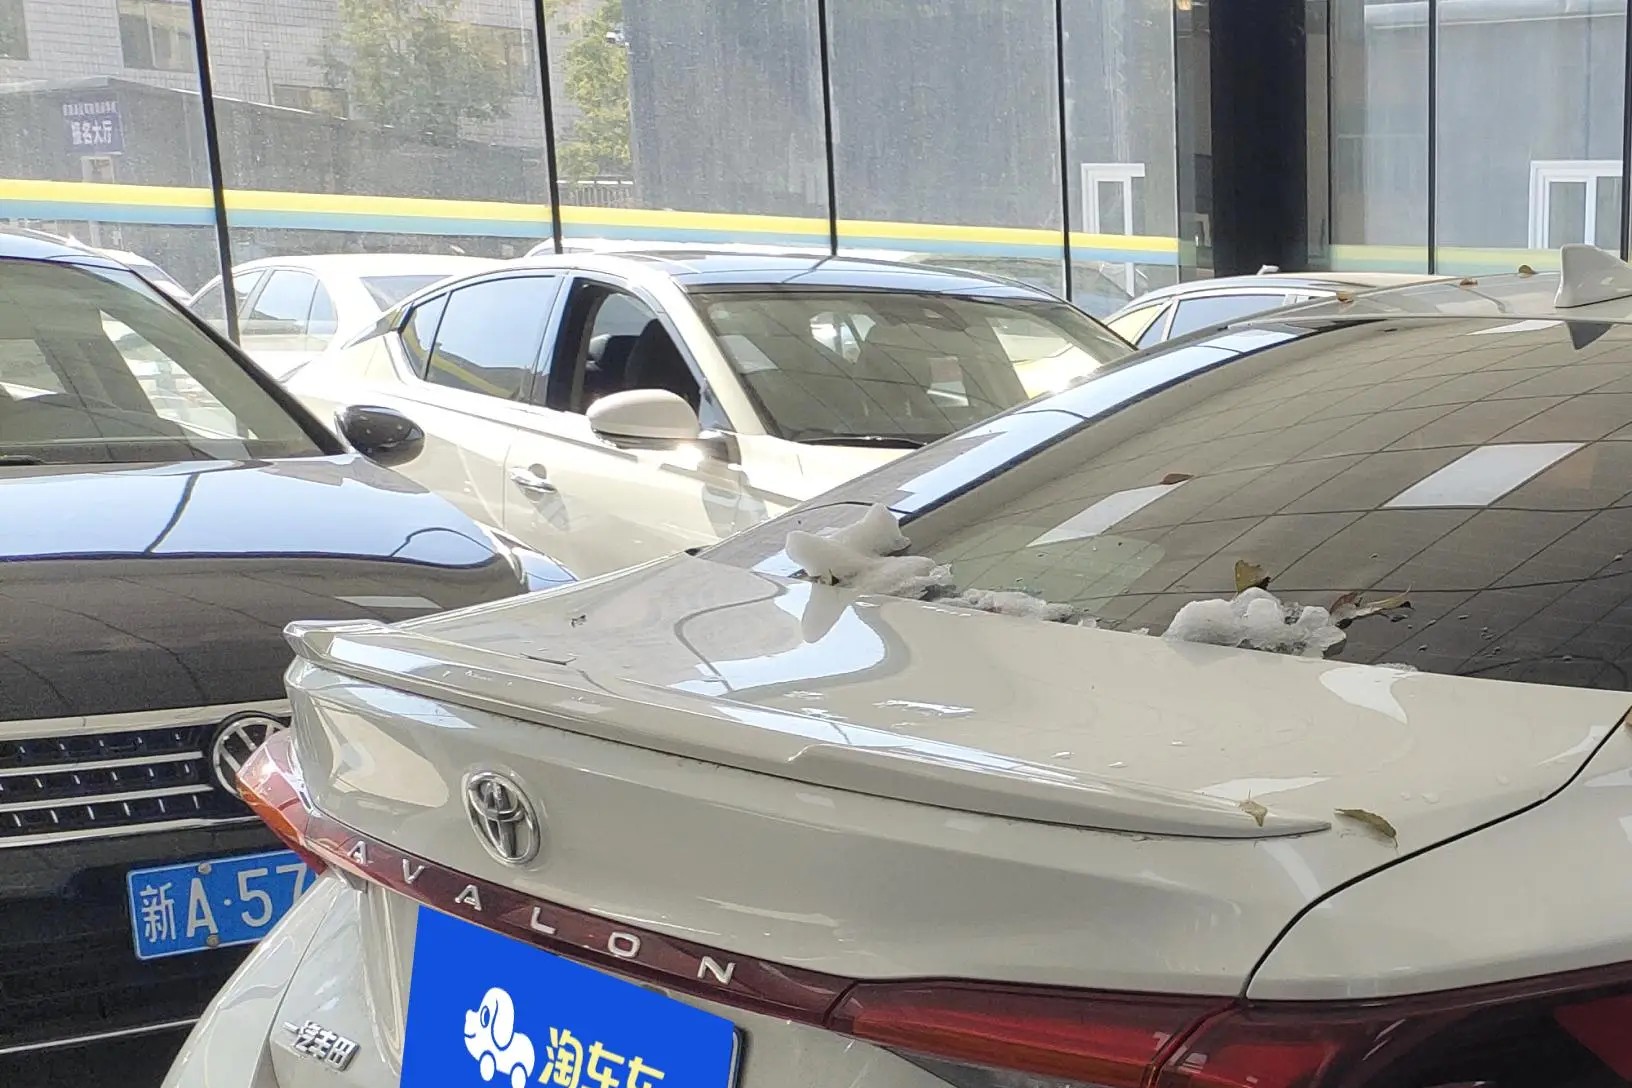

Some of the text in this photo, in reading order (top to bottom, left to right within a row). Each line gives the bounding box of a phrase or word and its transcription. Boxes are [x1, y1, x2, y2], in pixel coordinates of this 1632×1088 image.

[139, 862, 319, 943] 新A·57
[346, 839, 736, 985] AVALON
[283, 1020, 358, 1070] 一汽丰田
